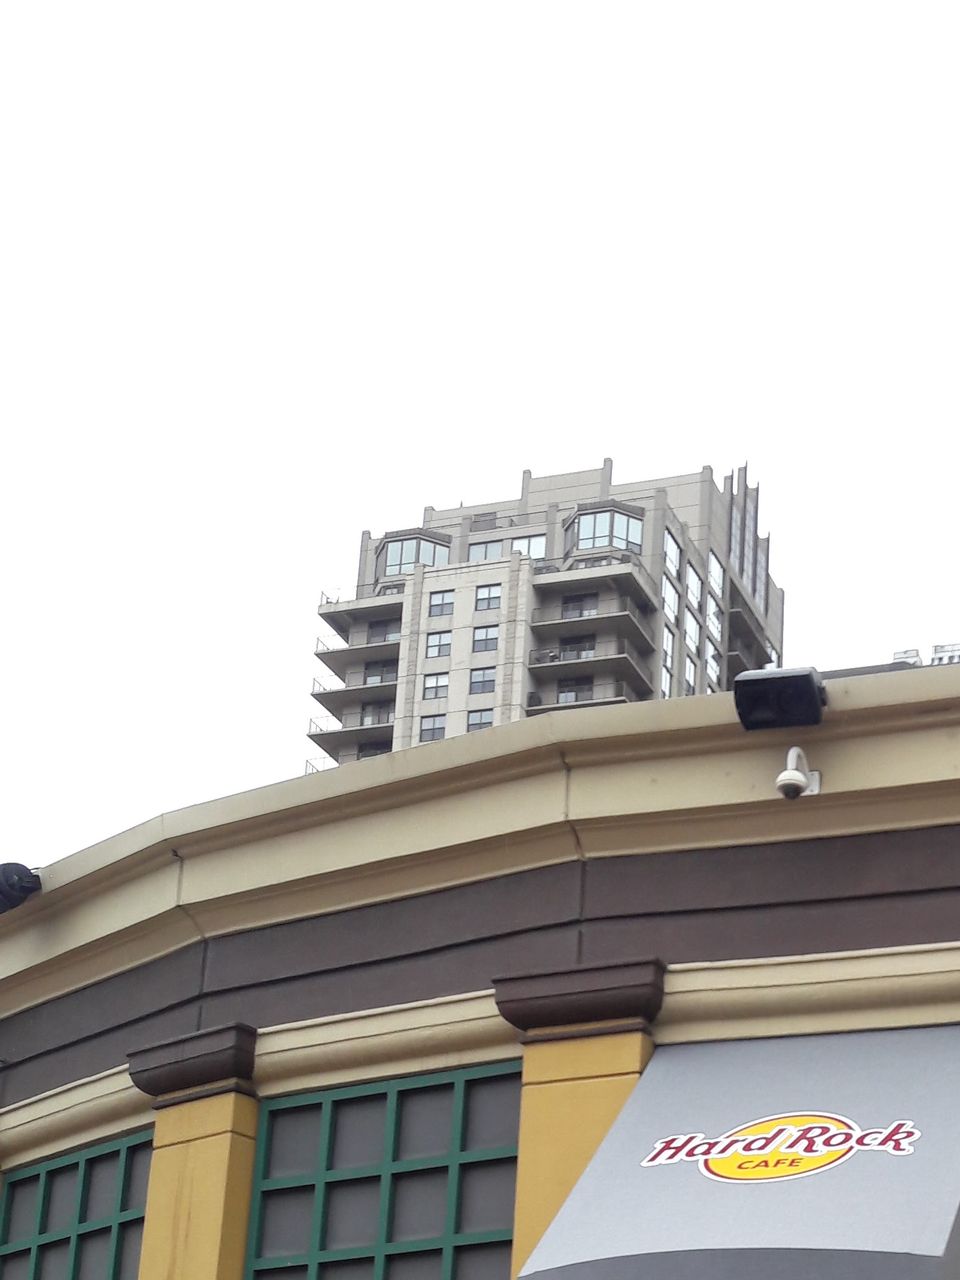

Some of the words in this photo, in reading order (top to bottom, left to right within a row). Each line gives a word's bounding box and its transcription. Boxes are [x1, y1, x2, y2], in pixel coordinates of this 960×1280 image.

[645, 1127, 788, 1163] Hard
[783, 1122, 916, 1153] Rock
[736, 1157, 804, 1171] CAFE
